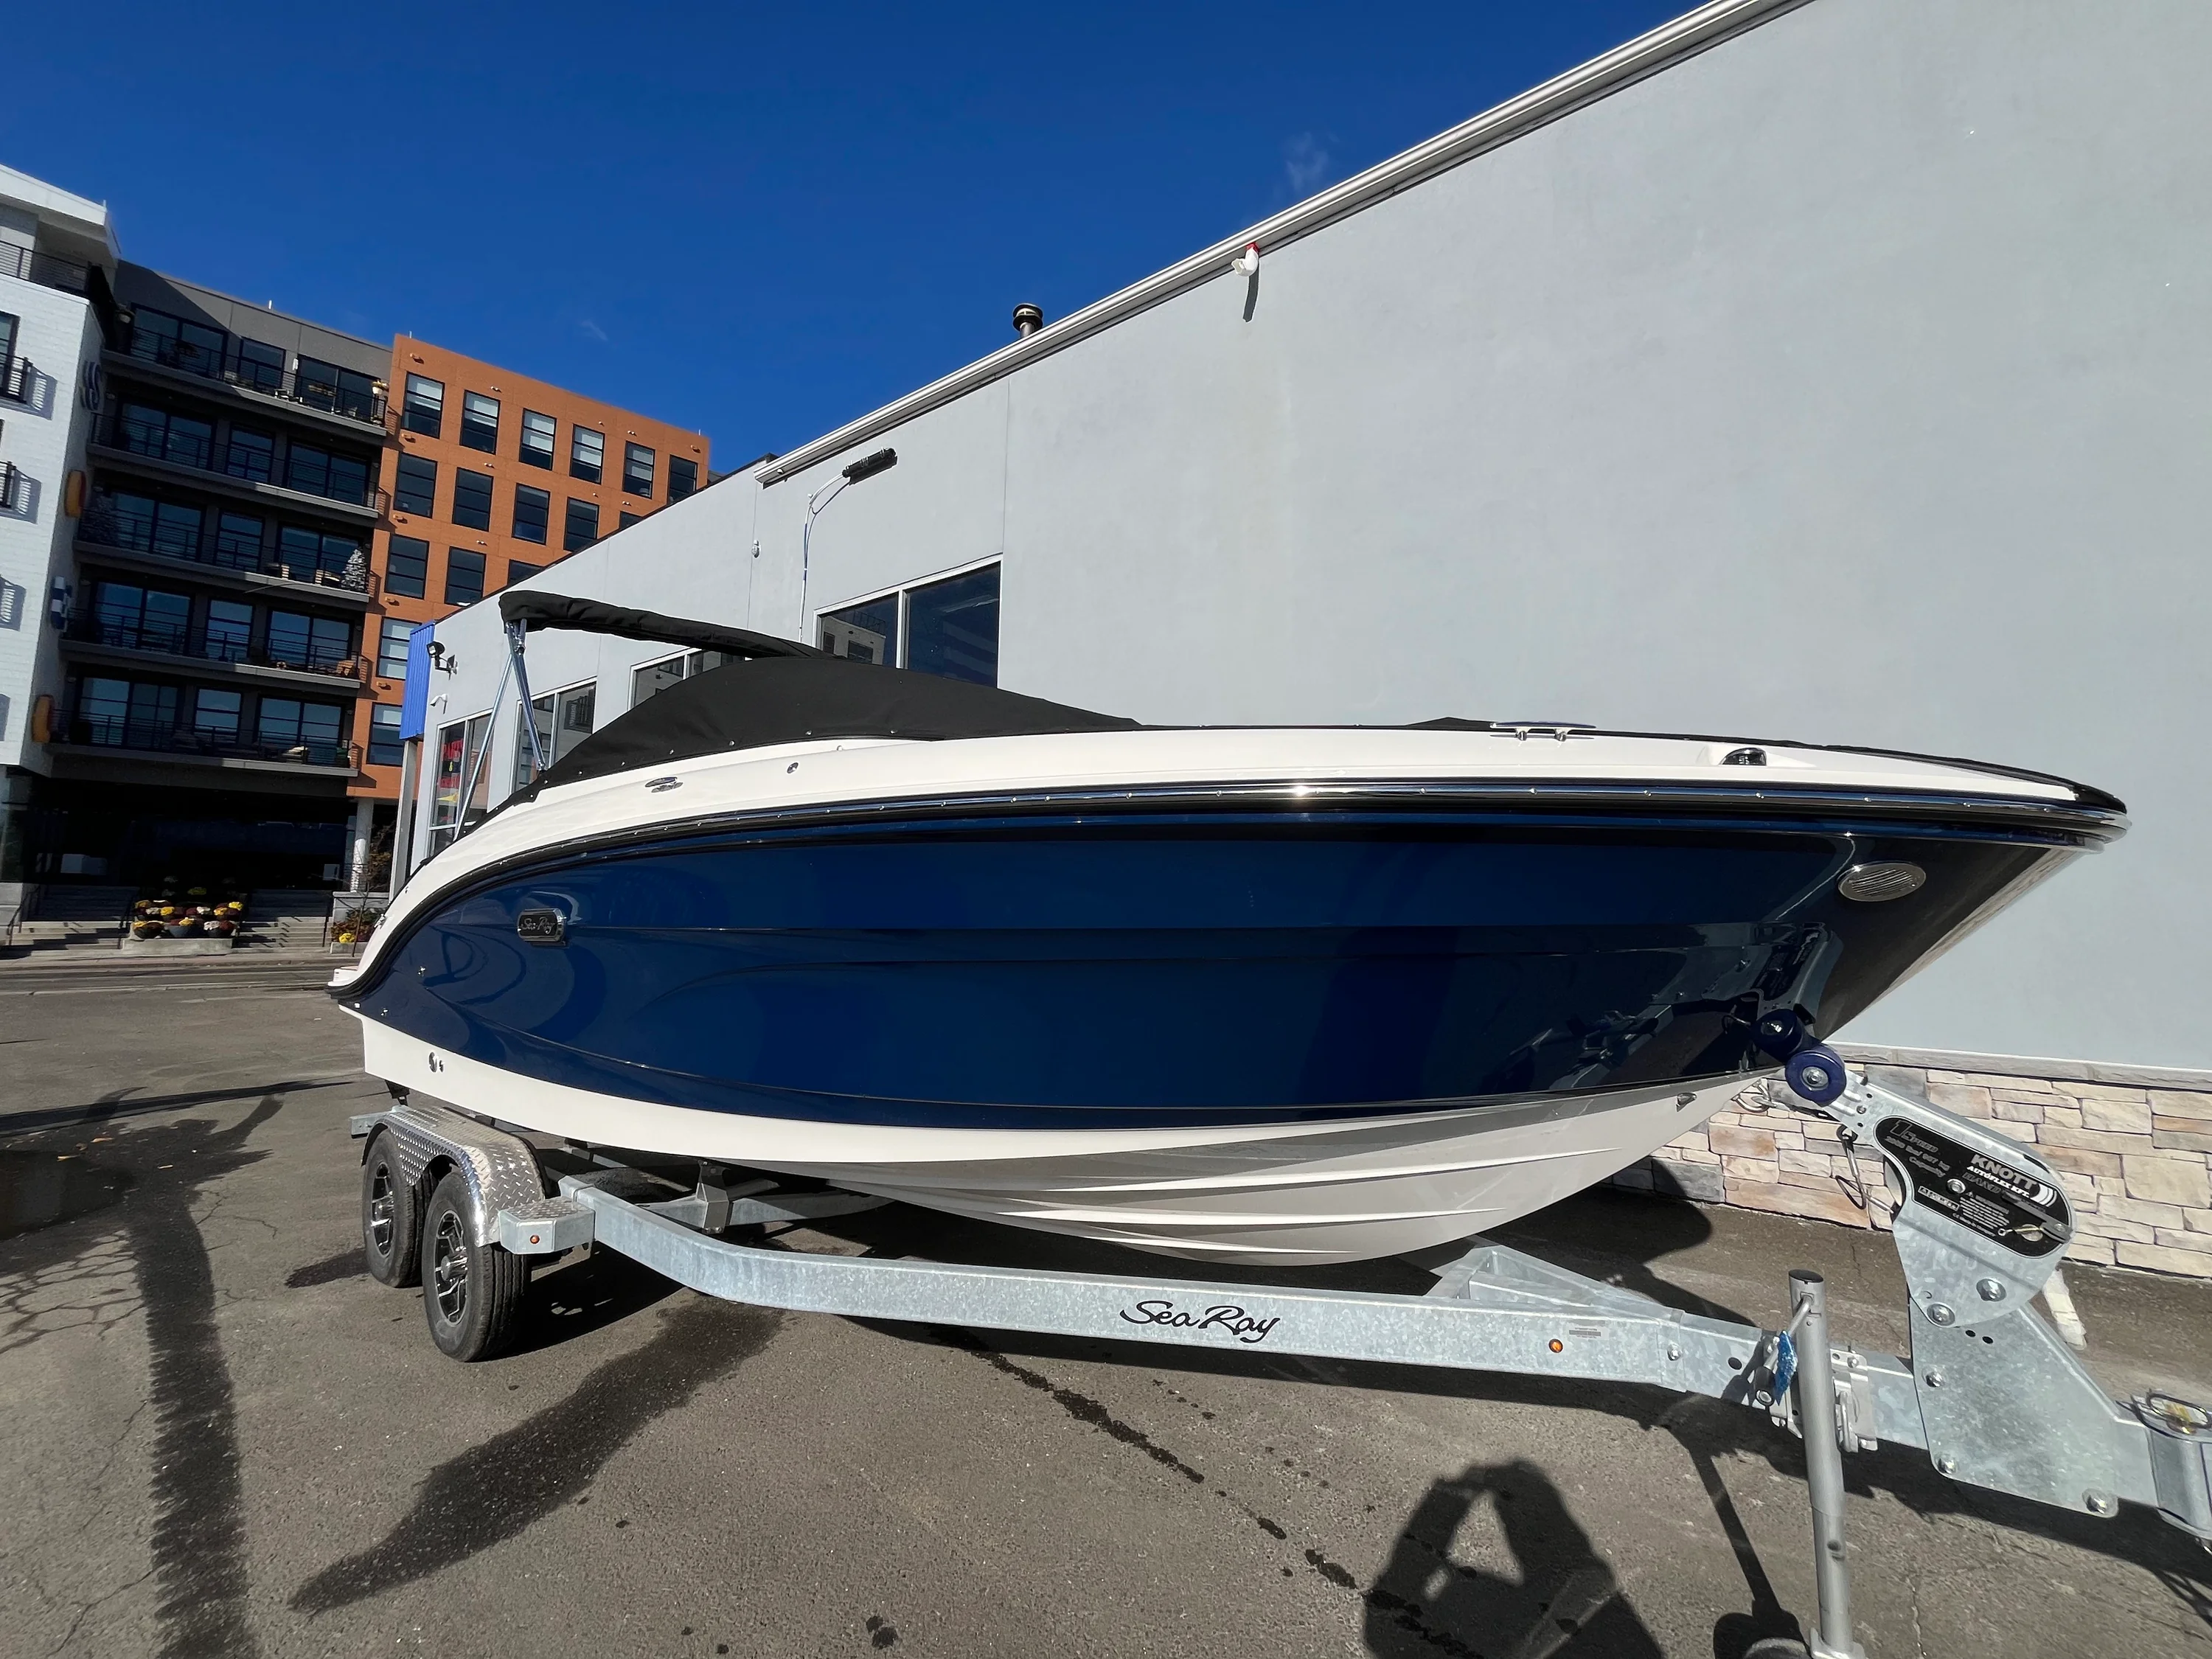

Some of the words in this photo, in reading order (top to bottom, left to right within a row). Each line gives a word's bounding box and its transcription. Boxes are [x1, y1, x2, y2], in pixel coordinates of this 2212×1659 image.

[1970, 1154, 2037, 1189] KNOTT
[1119, 1300, 1200, 1327] Sea
[1197, 1304, 1281, 1343] Ray
